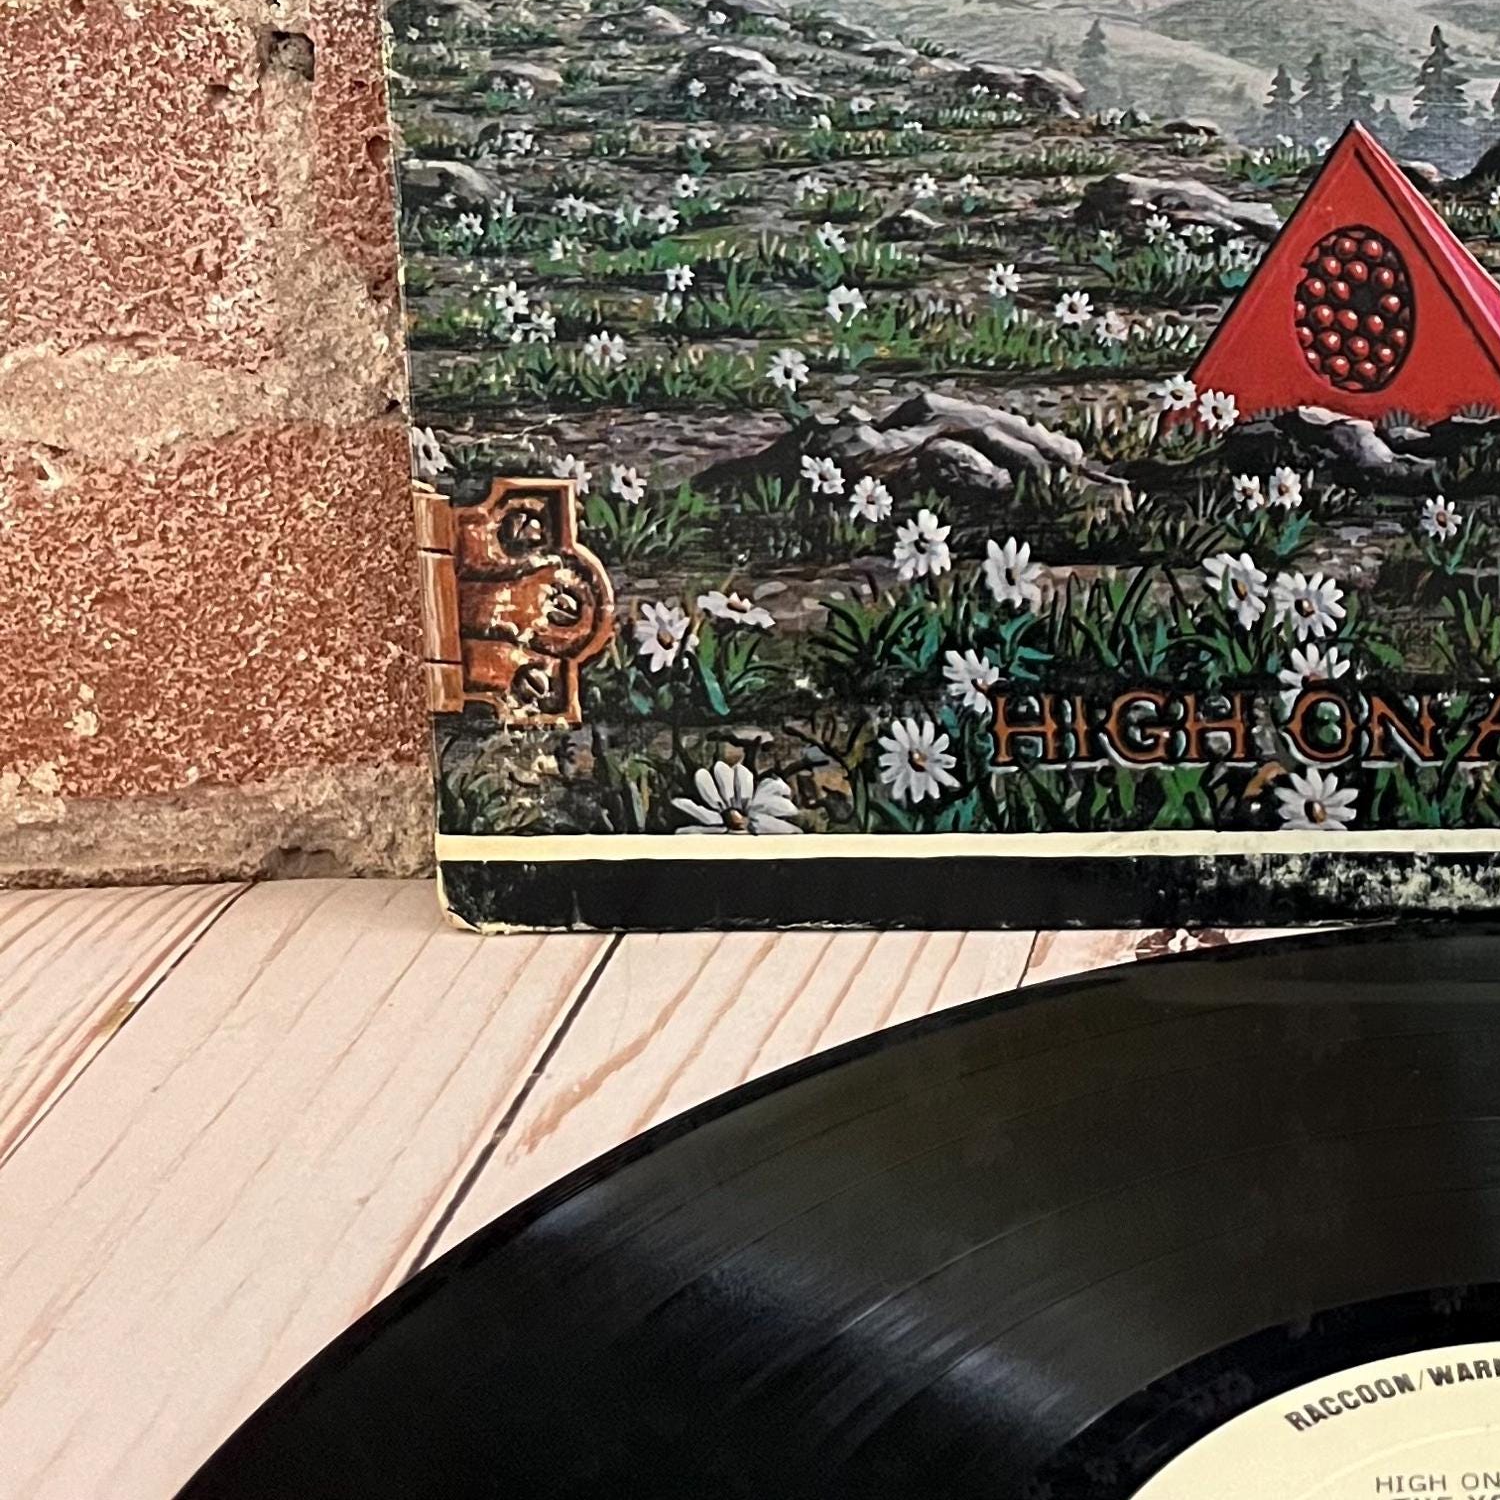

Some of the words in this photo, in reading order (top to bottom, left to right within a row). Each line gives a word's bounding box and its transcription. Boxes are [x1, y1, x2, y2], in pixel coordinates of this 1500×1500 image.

[992, 690, 1246, 763] HIGH
[1287, 690, 1434, 762] ON
[1375, 1474, 1447, 1494] HIGH
[1461, 1471, 1500, 1491] ON
